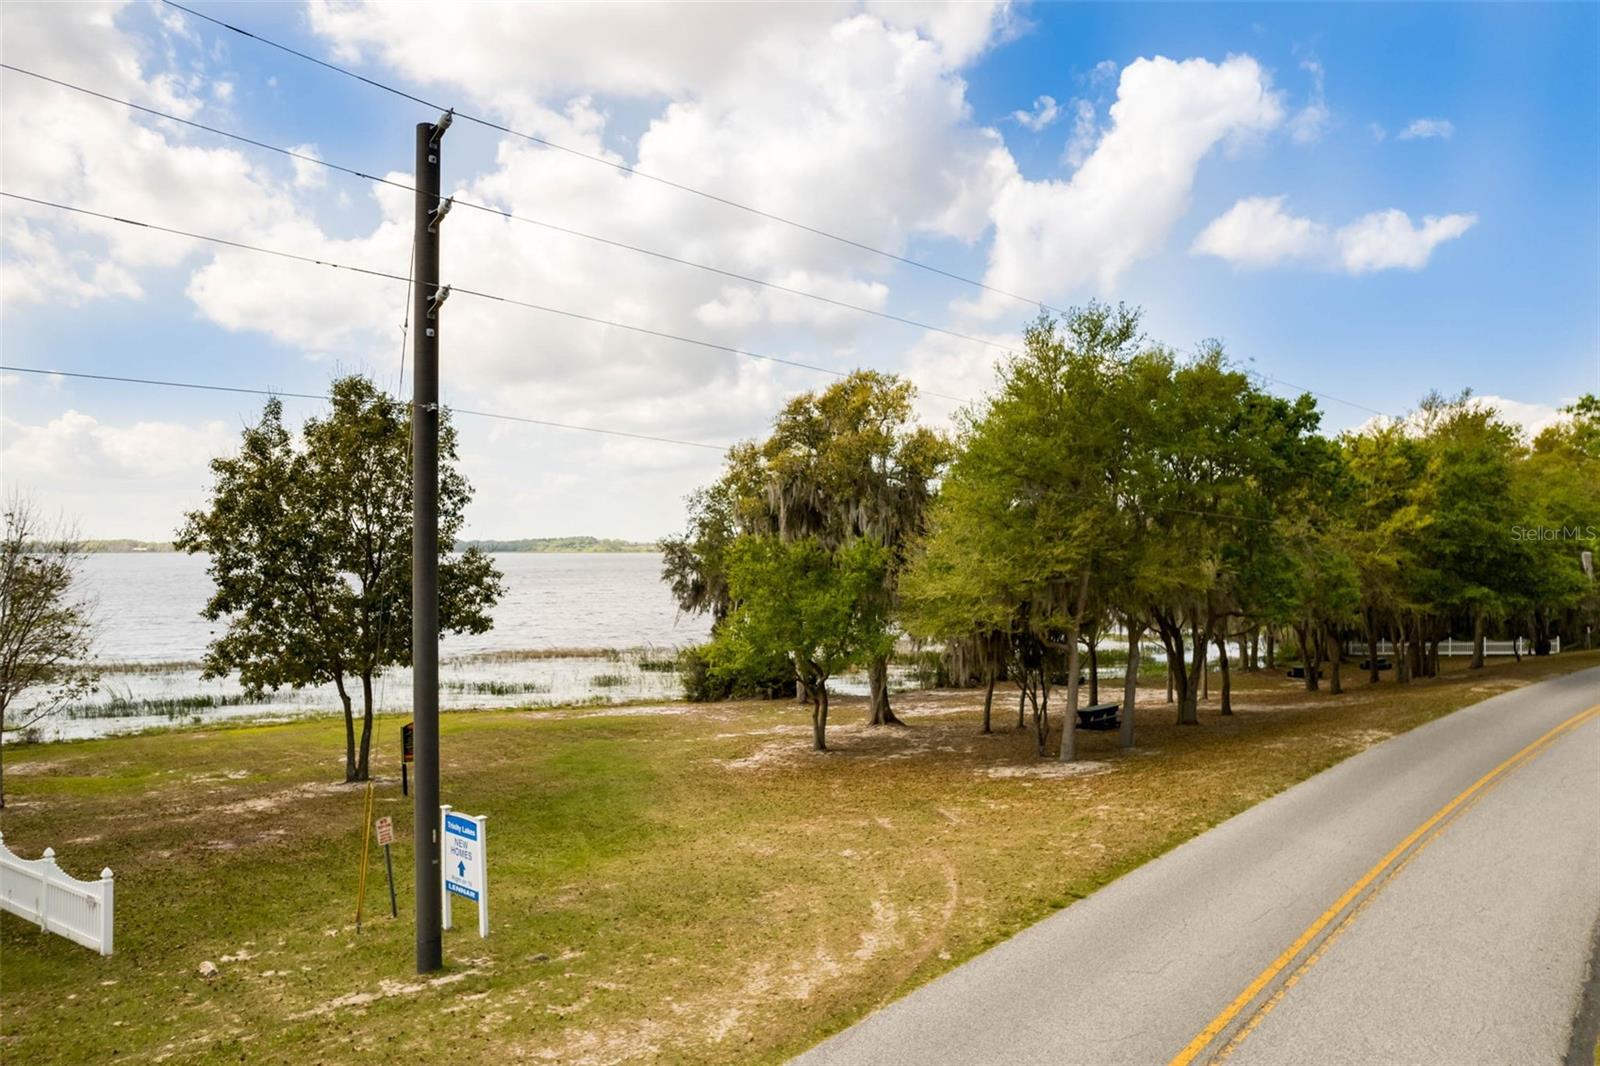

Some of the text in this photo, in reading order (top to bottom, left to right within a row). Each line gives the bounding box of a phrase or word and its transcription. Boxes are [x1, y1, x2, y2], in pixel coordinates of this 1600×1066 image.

[454, 838, 468, 849] NEW
[451, 847, 472, 861] HOMES
[448, 883, 476, 898] LENNAR
